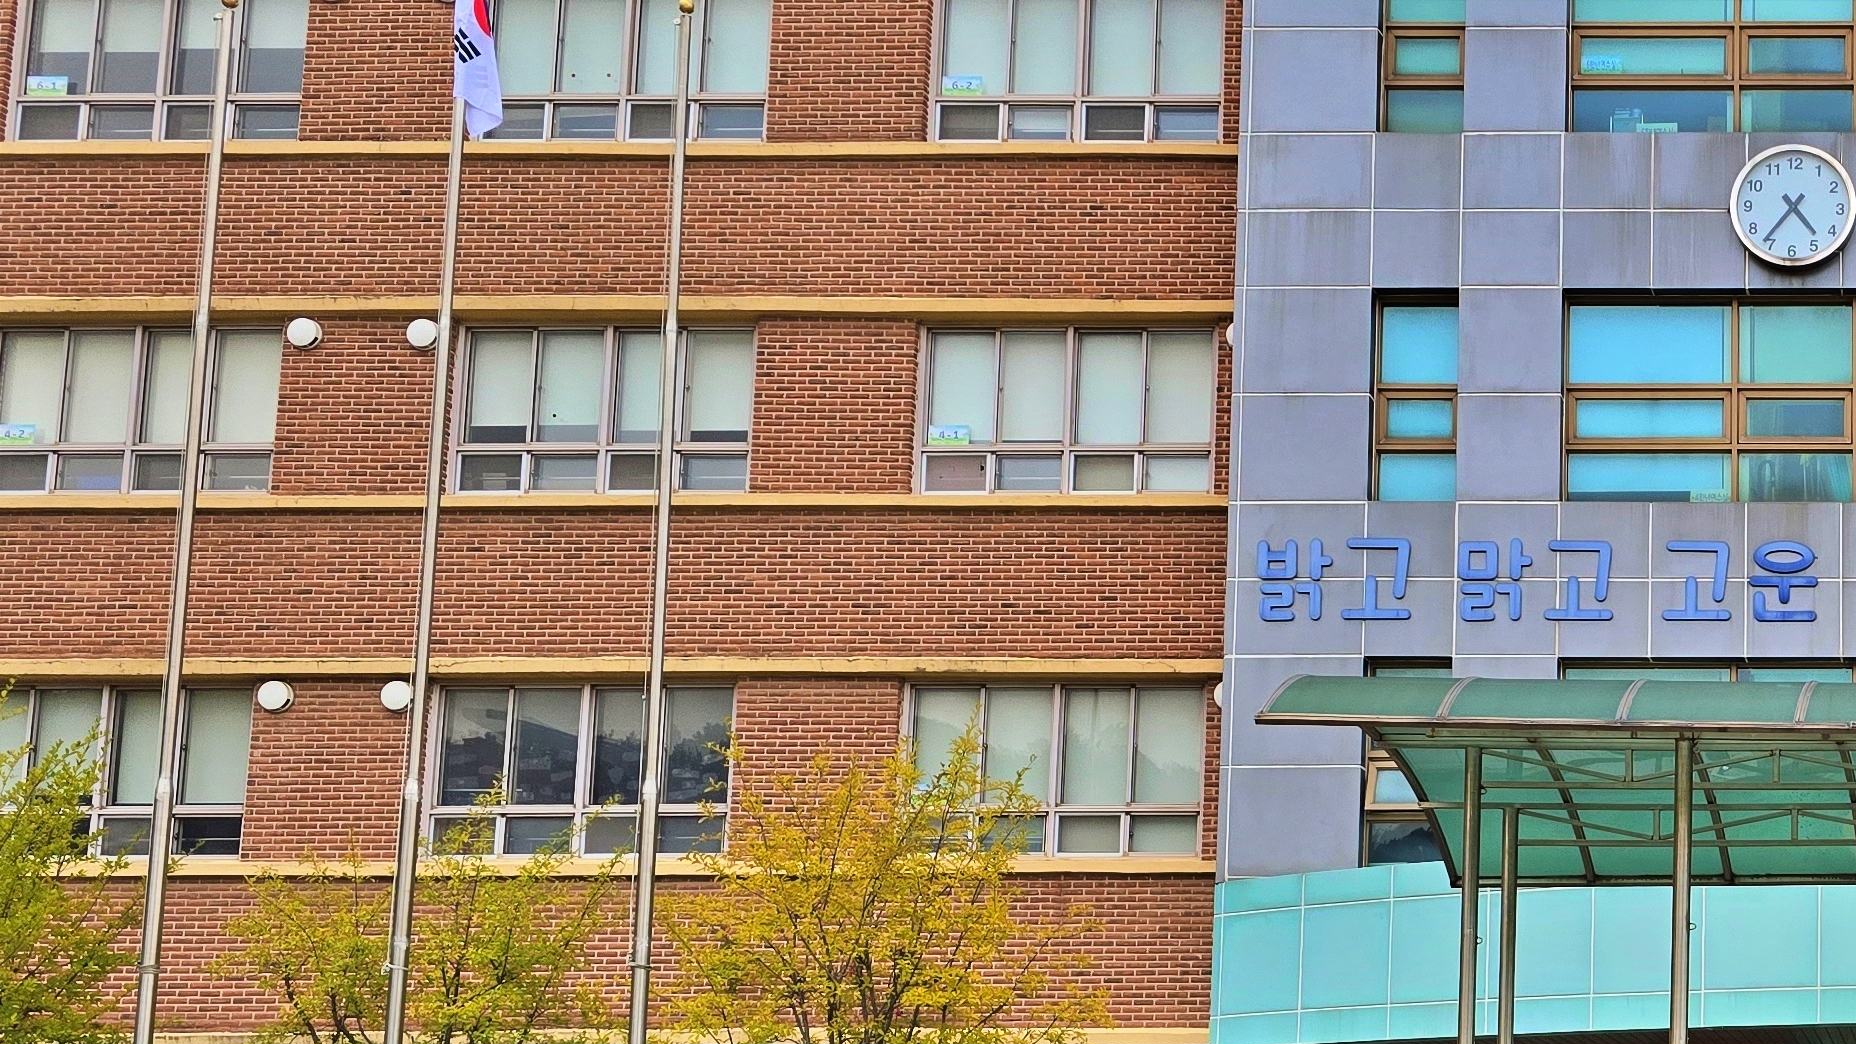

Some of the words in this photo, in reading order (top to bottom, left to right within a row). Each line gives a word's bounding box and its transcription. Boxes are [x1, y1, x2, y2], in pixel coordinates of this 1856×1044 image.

[37, 81, 57, 90] 6-1
[952, 81, 972, 90] 6-2
[1766, 163, 1780, 176] 11
[1787, 157, 1803, 170] 12
[1815, 165, 1821, 177] 1
[1747, 180, 1763, 192] 10
[1829, 181, 1838, 193] 2
[1743, 200, 1753, 212] 9
[1836, 203, 1845, 215] 3
[1749, 222, 1758, 235] 8
[1828, 225, 1837, 237] 4
[1767, 238, 1776, 251] 7
[1809, 240, 1819, 252] 5
[1788, 245, 1797, 257] 6
[4, 429, 25, 439] 4-2
[939, 431, 959, 440] 4-1
[1256, 538, 1412, 621] 밝고
[1459, 538, 1613, 621] 맑고
[1662, 539, 1818, 622] 고운
